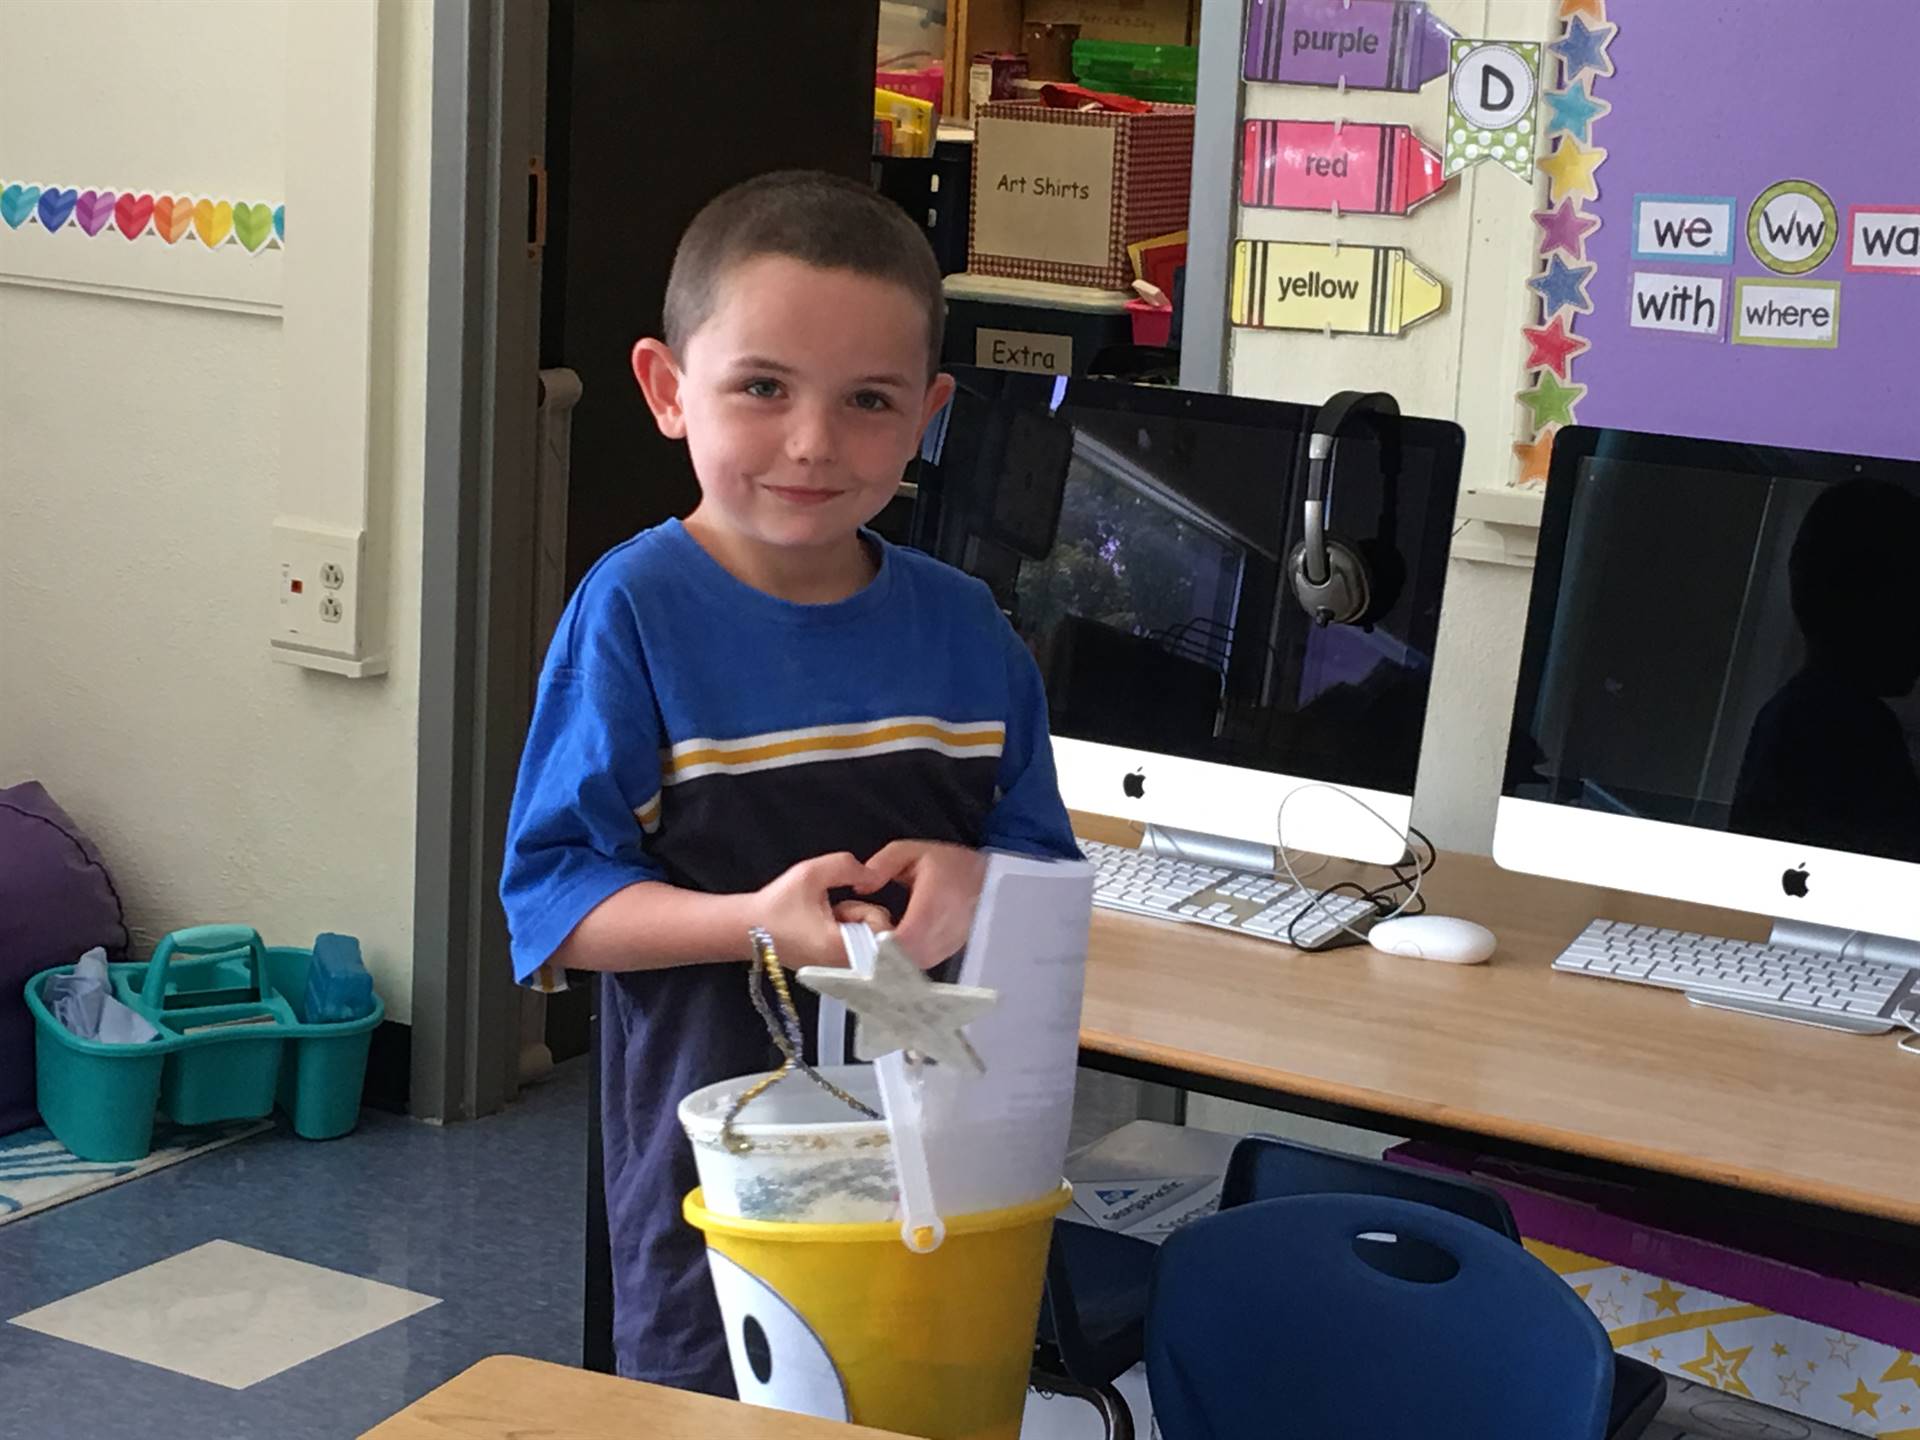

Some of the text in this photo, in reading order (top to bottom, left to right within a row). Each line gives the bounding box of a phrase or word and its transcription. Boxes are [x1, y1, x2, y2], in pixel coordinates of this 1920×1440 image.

[1293, 26, 1379, 57] purple
[1480, 64, 1514, 111] D
[1305, 153, 1348, 178] red
[996, 174, 1090, 200] Art Shirts
[1654, 217, 1713, 248] we
[1763, 210, 1825, 248] Ww
[1862, 225, 1920, 257] wa
[1278, 270, 1359, 302] yellow
[1637, 284, 1715, 328] with
[1746, 300, 1830, 327] where
[992, 339, 1055, 369] Extra
